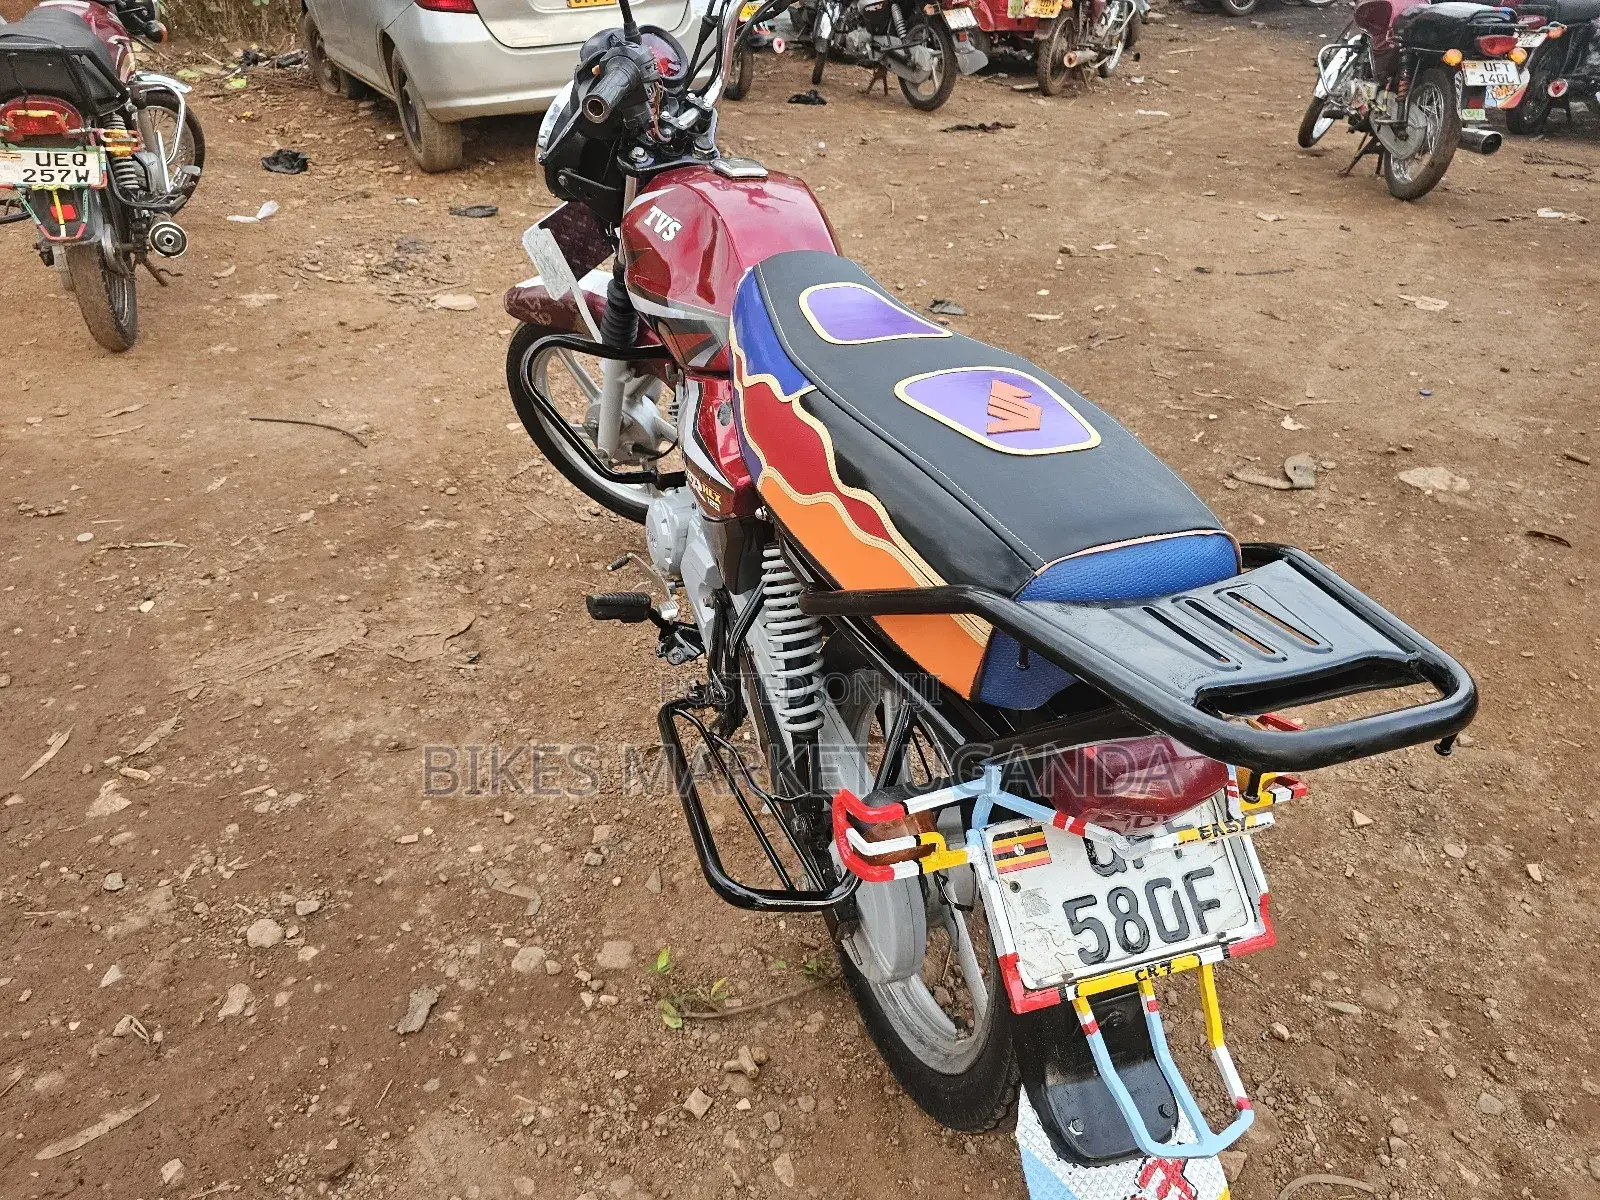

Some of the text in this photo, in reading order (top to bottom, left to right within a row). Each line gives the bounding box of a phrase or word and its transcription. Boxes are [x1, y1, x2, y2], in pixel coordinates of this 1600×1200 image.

[35, 152, 88, 168] UEQ
[22, 168, 90, 184] 257W
[643, 205, 682, 241] TVS
[1062, 866, 1221, 965] 580F
